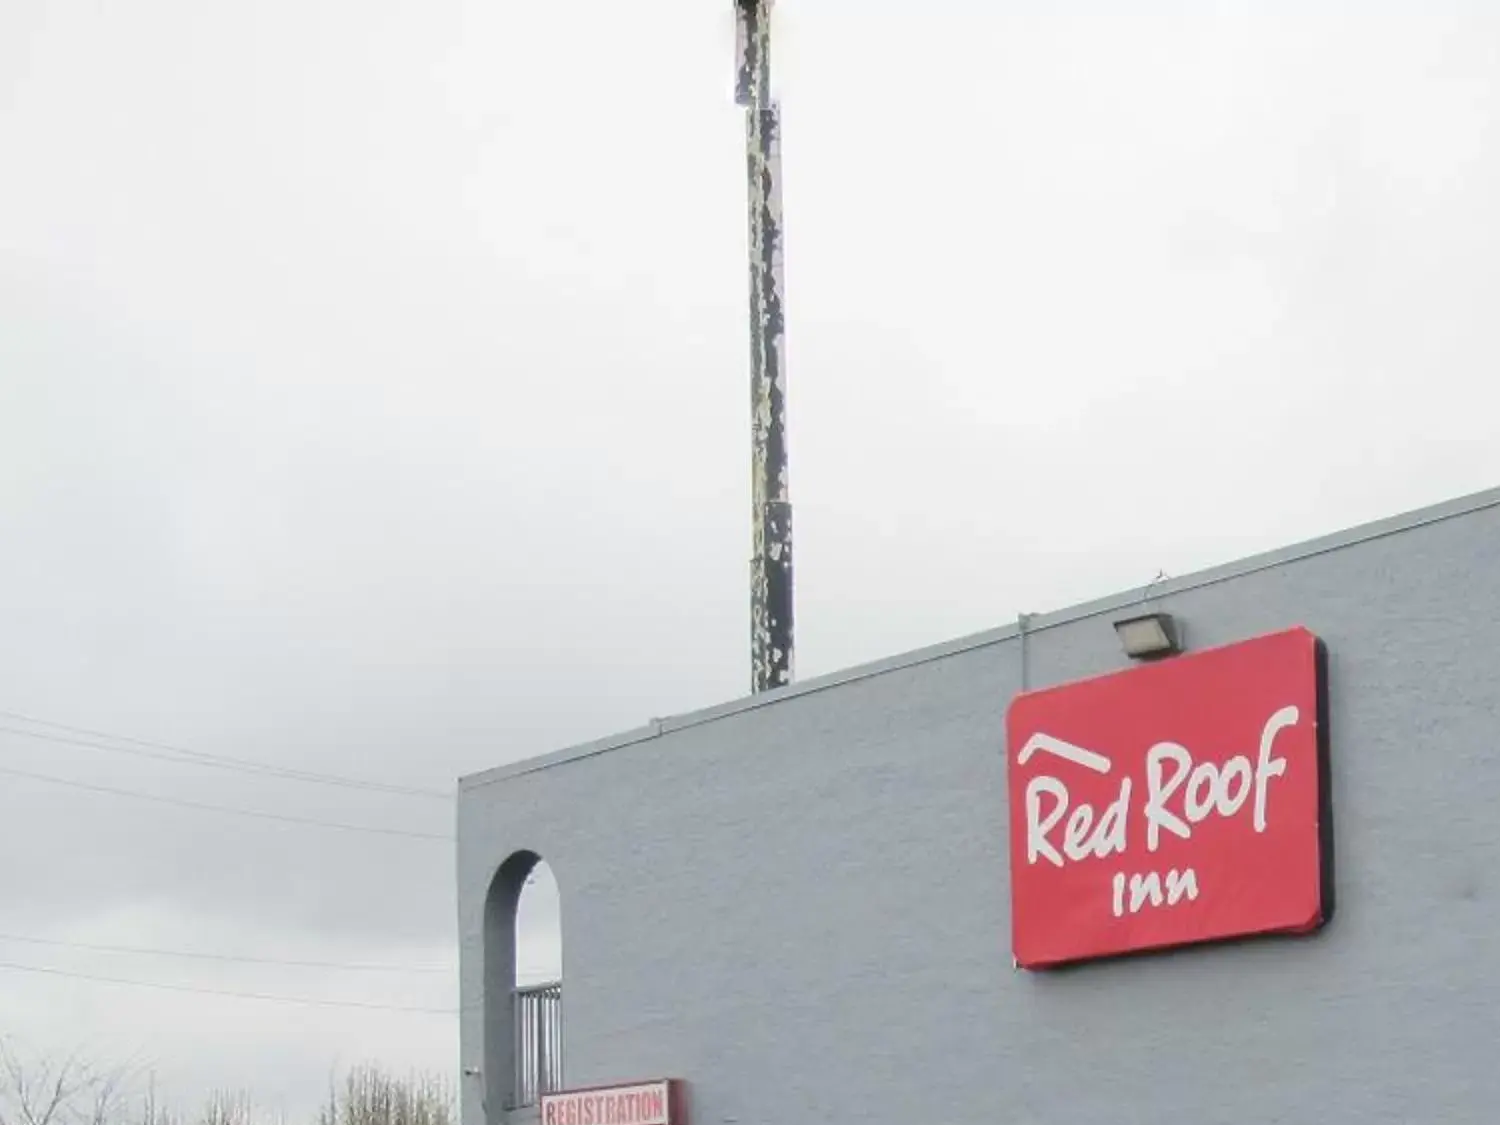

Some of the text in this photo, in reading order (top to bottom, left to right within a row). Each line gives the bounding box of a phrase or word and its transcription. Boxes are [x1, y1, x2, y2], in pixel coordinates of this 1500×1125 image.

[1025, 705, 1299, 867] Red Roof
[1112, 868, 1198, 917] Inn
